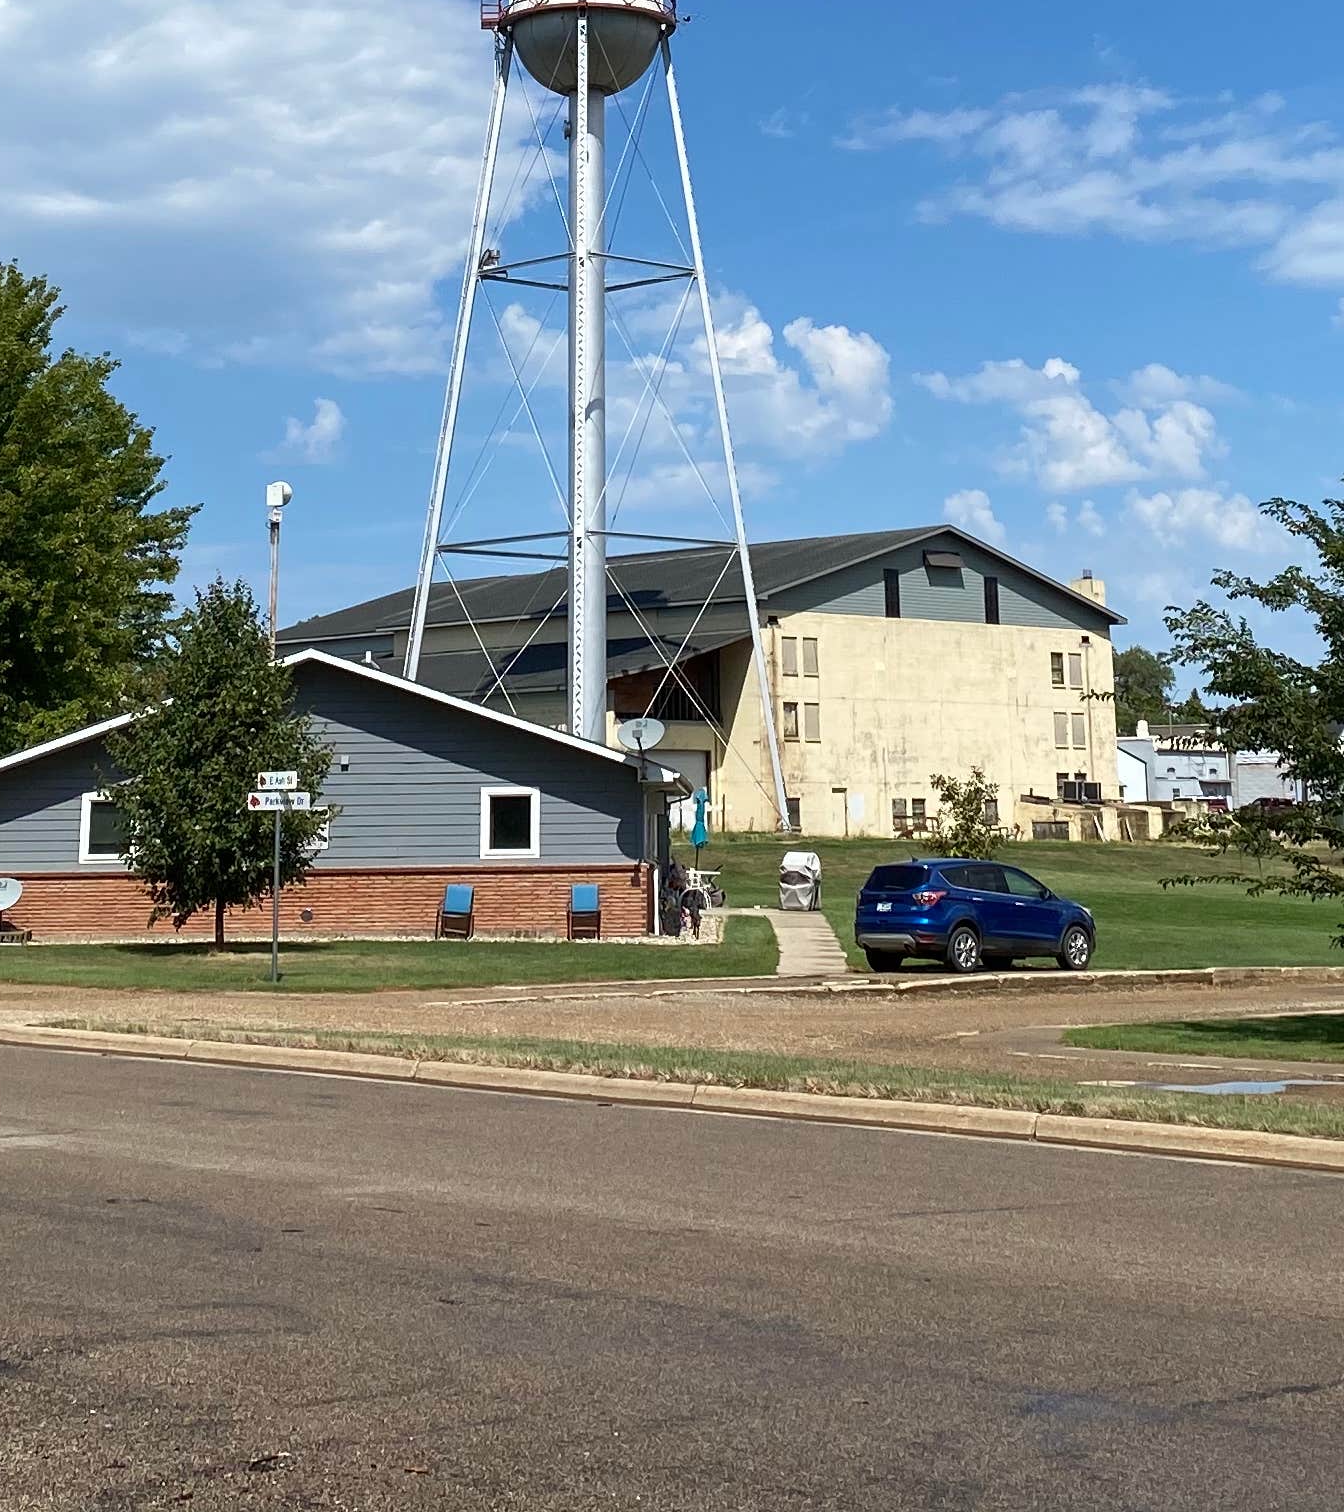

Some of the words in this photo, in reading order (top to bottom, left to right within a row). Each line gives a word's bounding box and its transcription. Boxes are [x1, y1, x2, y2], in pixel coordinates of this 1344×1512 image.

[270, 776, 273, 785] E
[275, 777, 285, 785] Ash
[287, 775, 292, 785] St
[265, 796, 295, 805] Parkview
[297, 796, 304, 805] Dr
